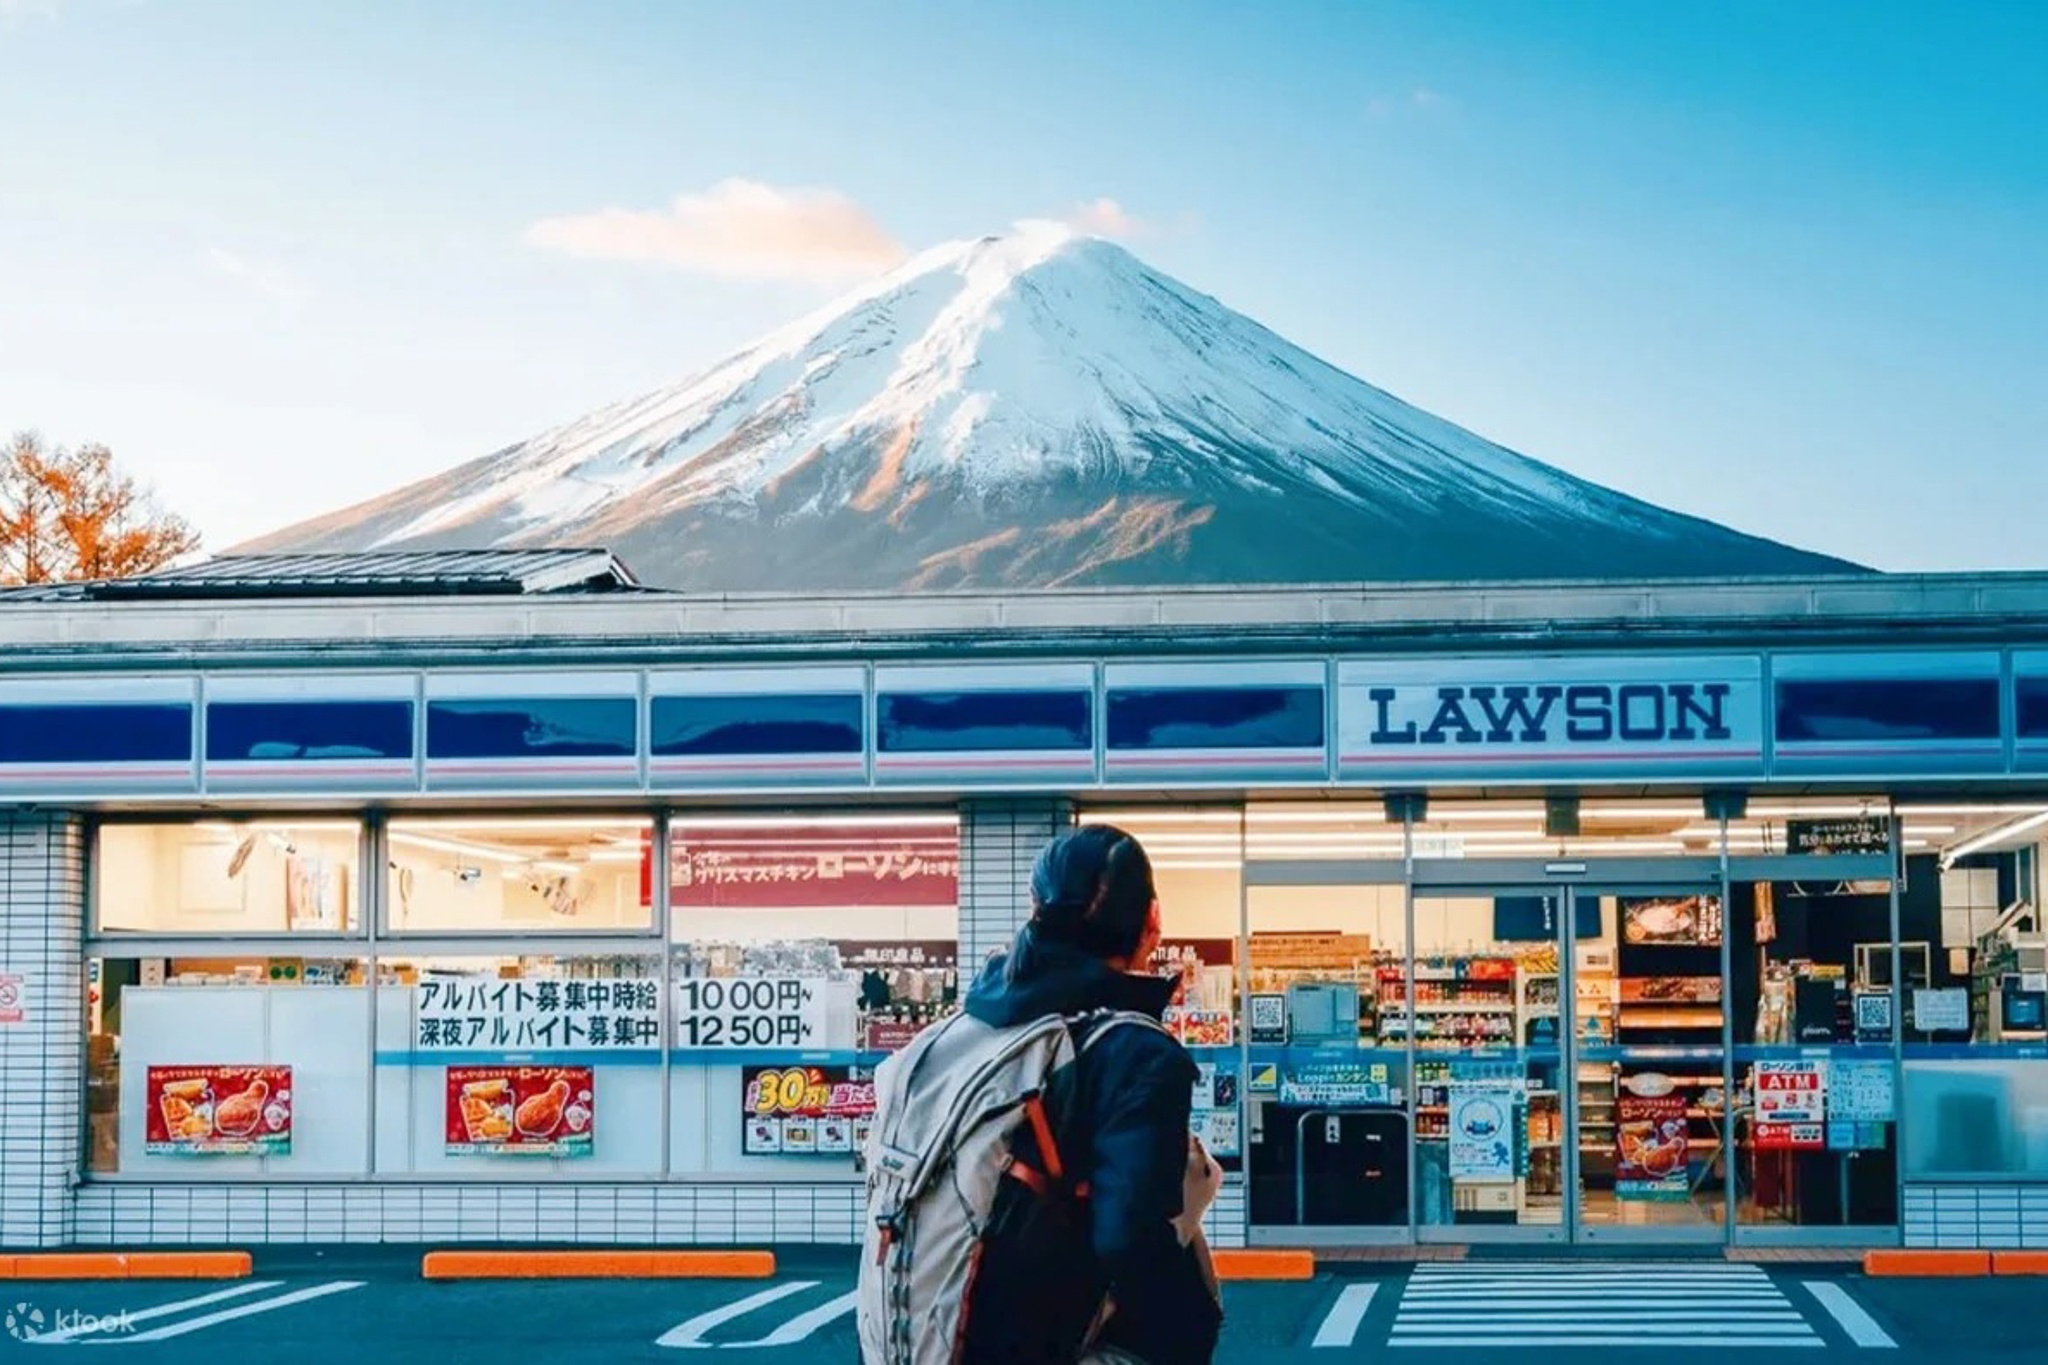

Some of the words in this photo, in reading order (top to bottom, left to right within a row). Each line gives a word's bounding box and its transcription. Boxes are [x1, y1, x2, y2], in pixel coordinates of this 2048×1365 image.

[1369, 684, 1731, 744] LAWSON
[419, 981, 657, 1011] アルバイト募集中時給
[418, 1017, 659, 1047] 深夜アルバイト募集中
[1767, 1074, 1811, 1089] ATM
